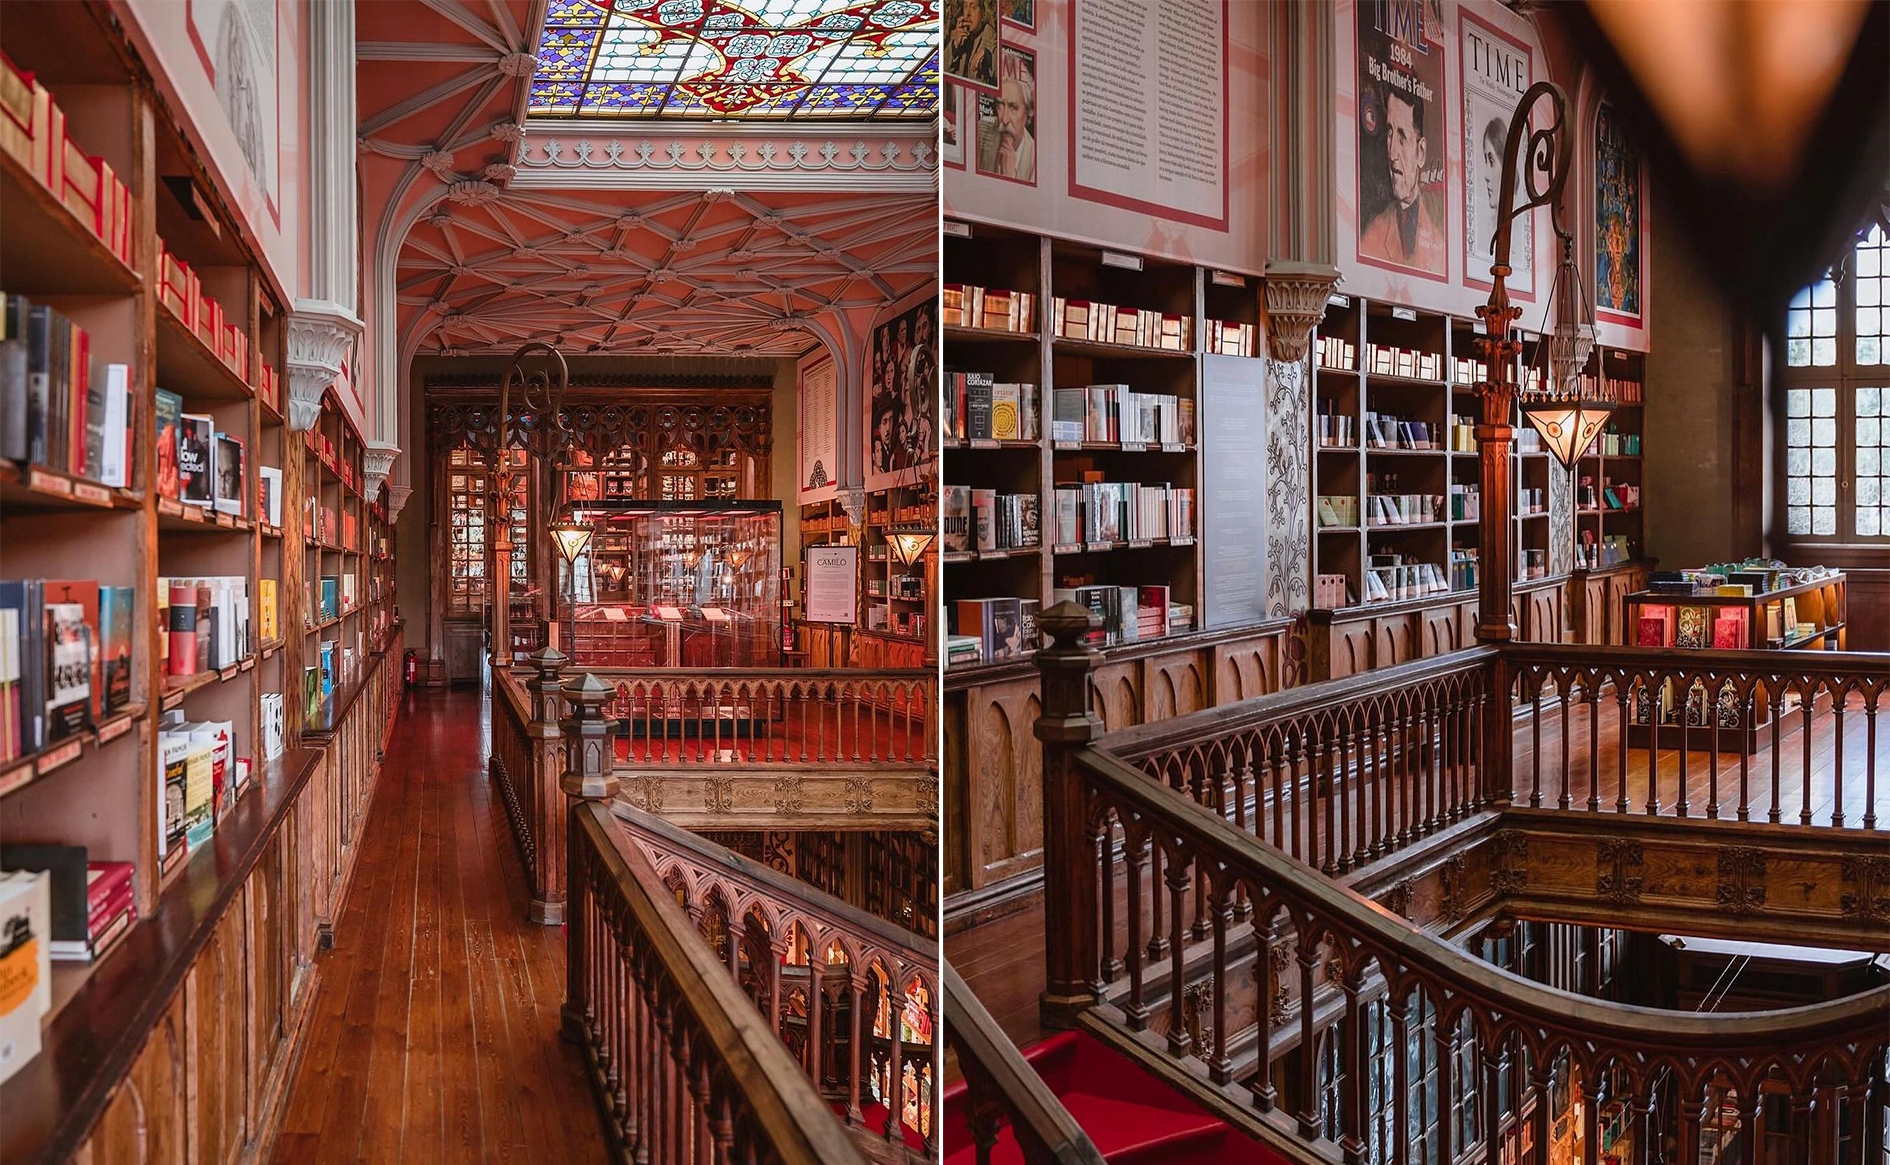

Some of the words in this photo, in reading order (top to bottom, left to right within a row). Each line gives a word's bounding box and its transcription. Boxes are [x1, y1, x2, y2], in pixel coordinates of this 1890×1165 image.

[1002, 54, 1028, 83] ME
[1390, 43, 1413, 69] 1984
[1468, 32, 1525, 94] TIME
[1368, 55, 1381, 81] Big
[1382, 62, 1412, 93] Brother's
[1413, 77, 1433, 103] Father
[569, 471, 597, 481] TIME
